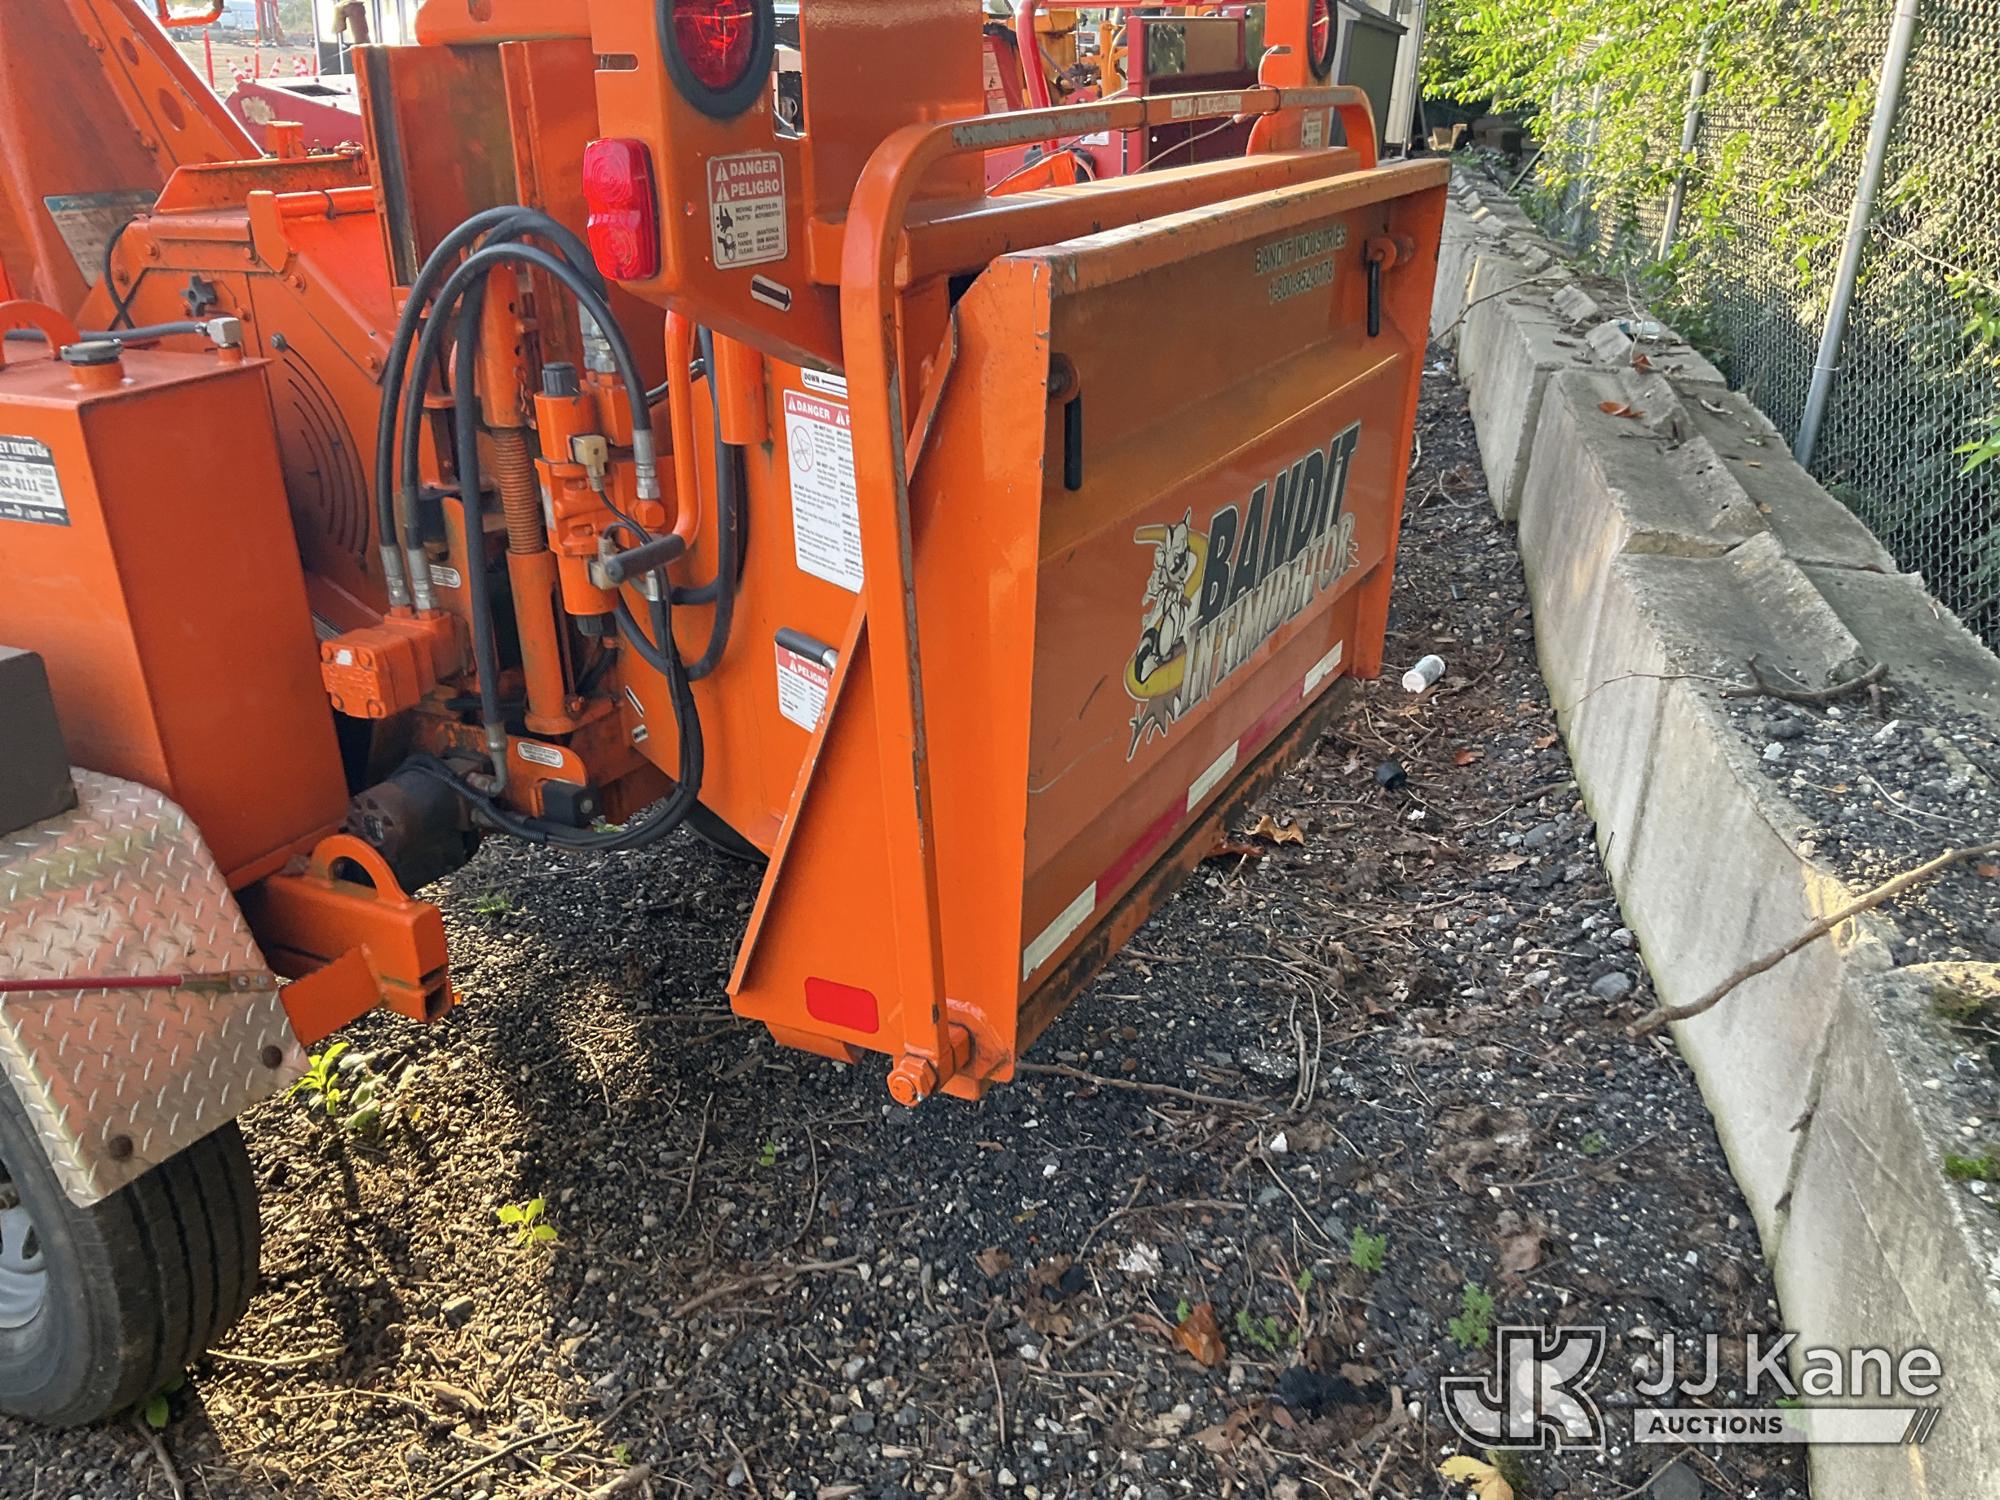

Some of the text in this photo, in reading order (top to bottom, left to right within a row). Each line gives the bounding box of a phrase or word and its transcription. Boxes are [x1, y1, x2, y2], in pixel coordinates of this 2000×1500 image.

[729, 160, 777, 177] DANGER
[730, 180, 780, 198] PELIGRO
[1255, 224, 1347, 276] BANDIT INDUSTRIES
[804, 372, 820, 383] DOWN
[796, 399, 831, 421] DANGER
[1200, 420, 1361, 627] BANDIT
[1174, 513, 1358, 722] INTIMIDATOR
